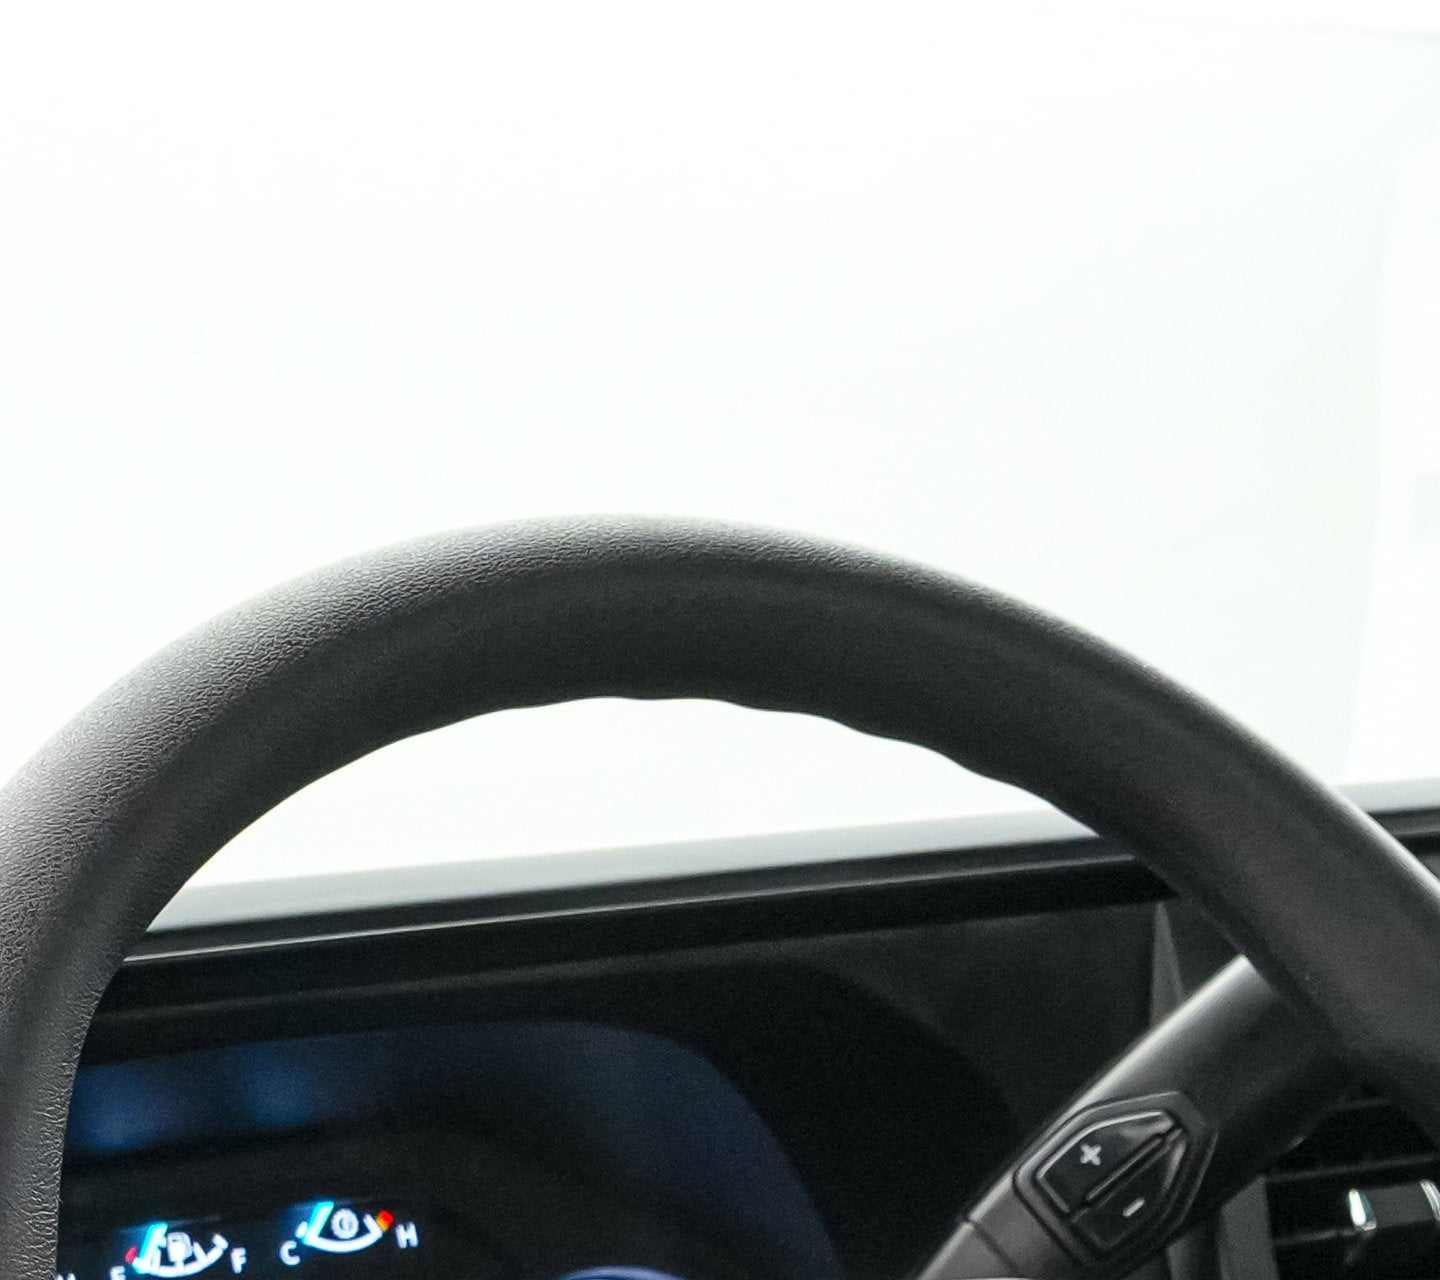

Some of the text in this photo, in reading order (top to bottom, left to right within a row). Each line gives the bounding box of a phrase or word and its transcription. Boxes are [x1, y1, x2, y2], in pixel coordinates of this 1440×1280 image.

[396, 1223, 419, 1249] H
[230, 1247, 248, 1274] F
[279, 1240, 301, 1266] C
